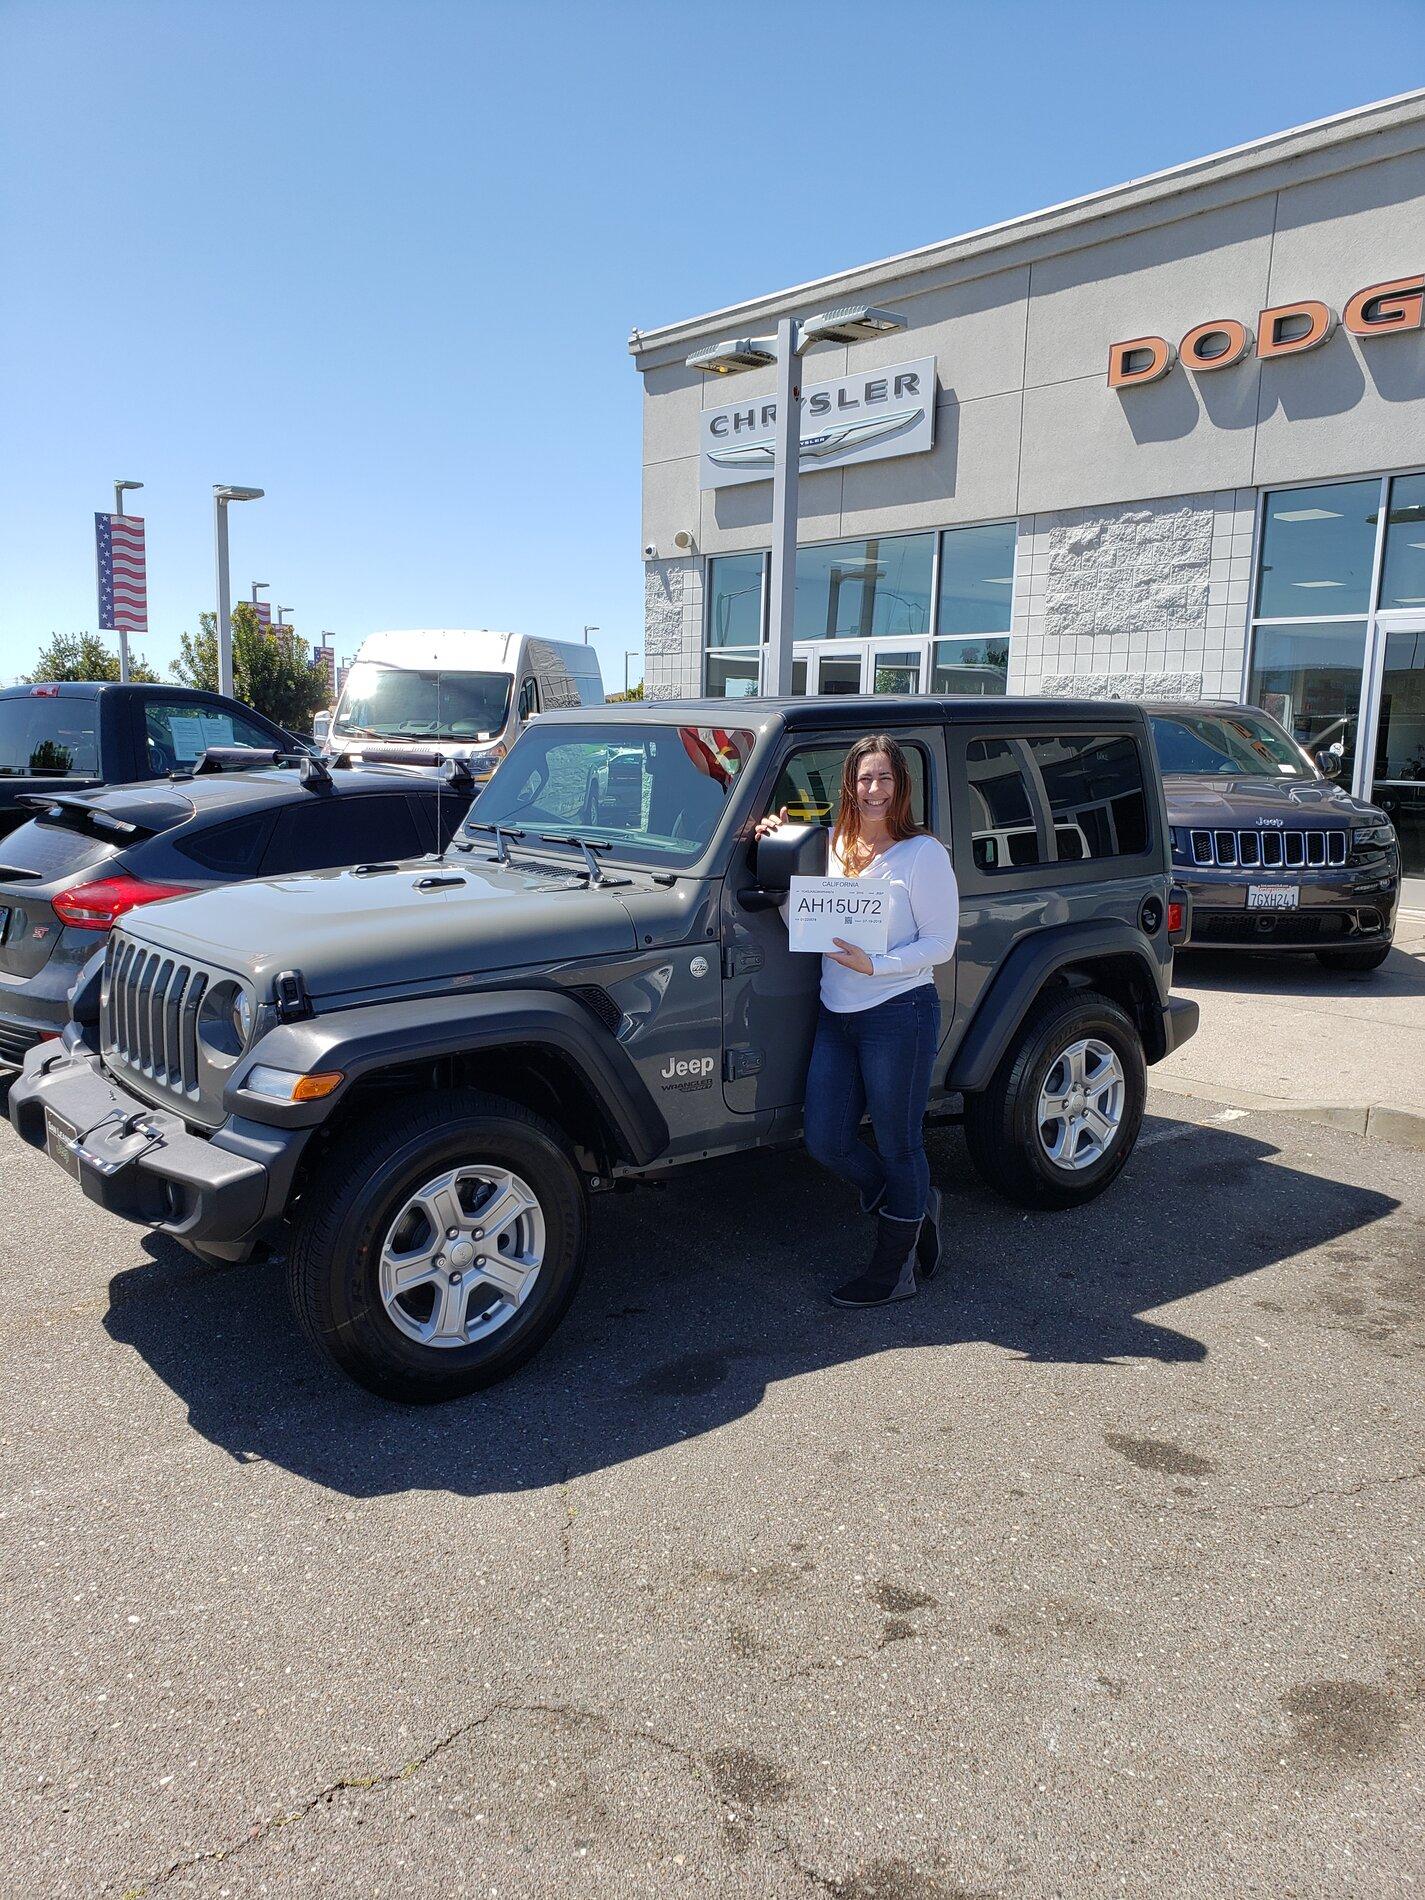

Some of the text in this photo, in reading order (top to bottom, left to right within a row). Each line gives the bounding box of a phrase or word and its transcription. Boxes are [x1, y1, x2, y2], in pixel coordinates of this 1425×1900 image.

[709, 372, 920, 437] CHRSLER
[1255, 816, 1284, 828] Jeep
[798, 898, 882, 915] AH15U72
[1250, 893, 1296, 907] 7GXH241
[661, 1056, 714, 1078] Jeep
[661, 1078, 713, 1092] WRANGLER
